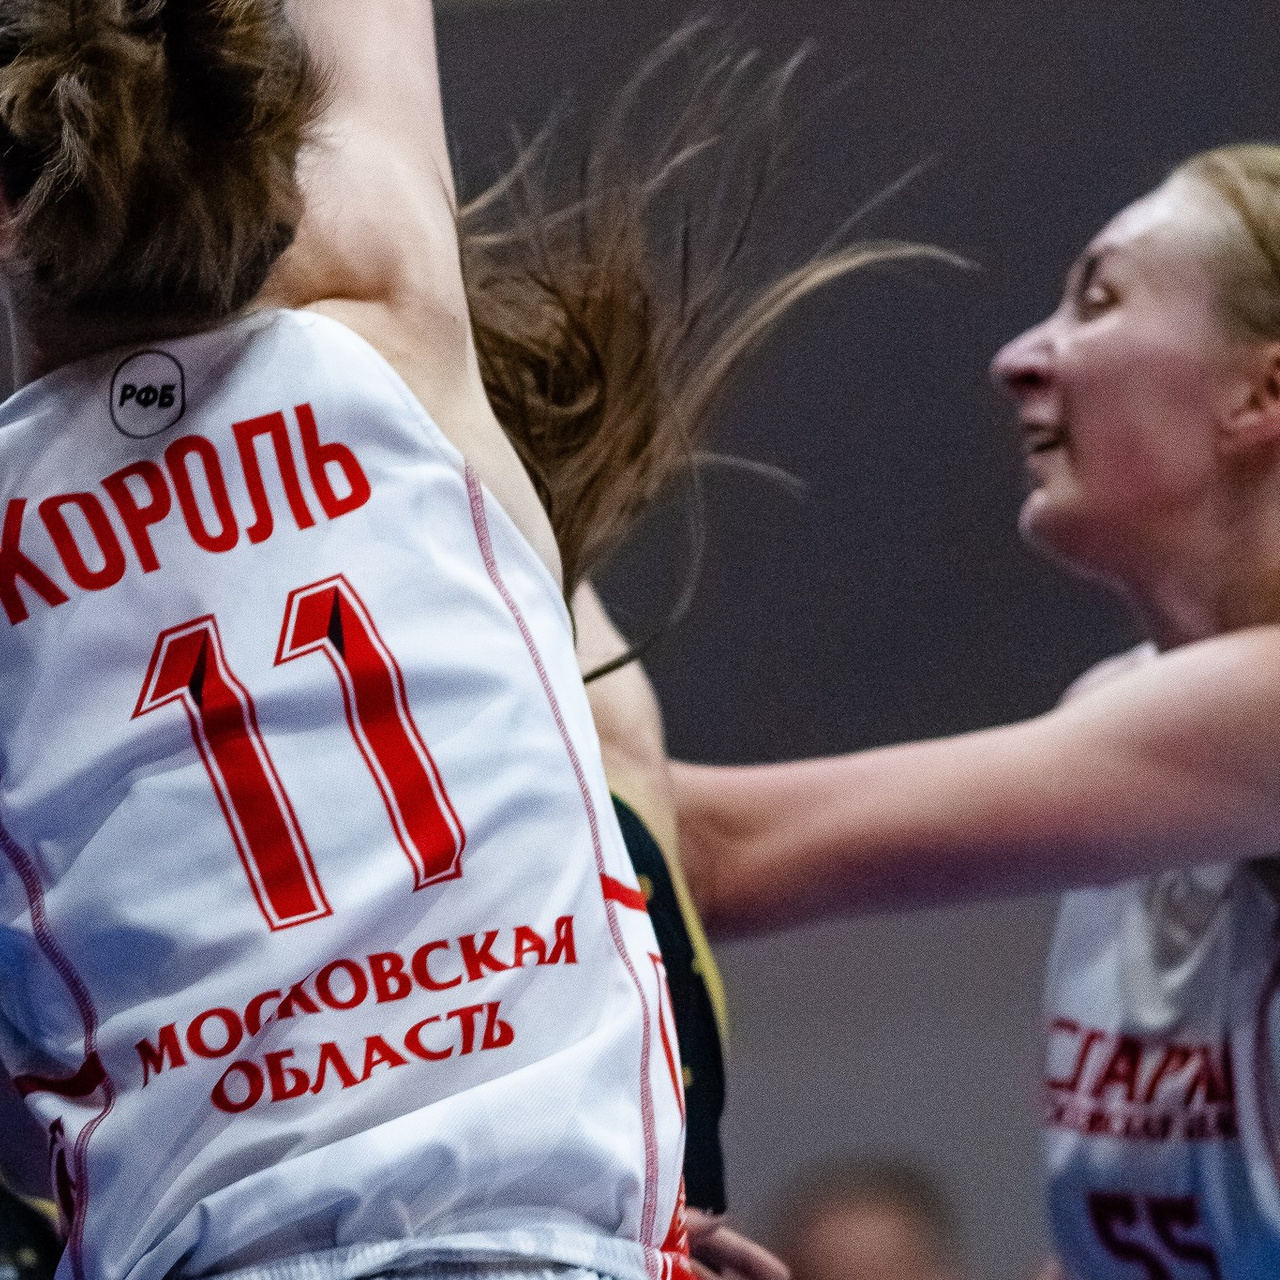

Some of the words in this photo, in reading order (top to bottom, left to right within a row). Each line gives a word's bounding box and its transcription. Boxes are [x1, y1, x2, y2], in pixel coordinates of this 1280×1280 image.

[119, 383, 176, 409] РФБ
[131, 573, 466, 932] 11
[134, 915, 578, 1088] МОСКОВСКАЯ
[210, 1001, 516, 1113] ОБЛАСТЬ
